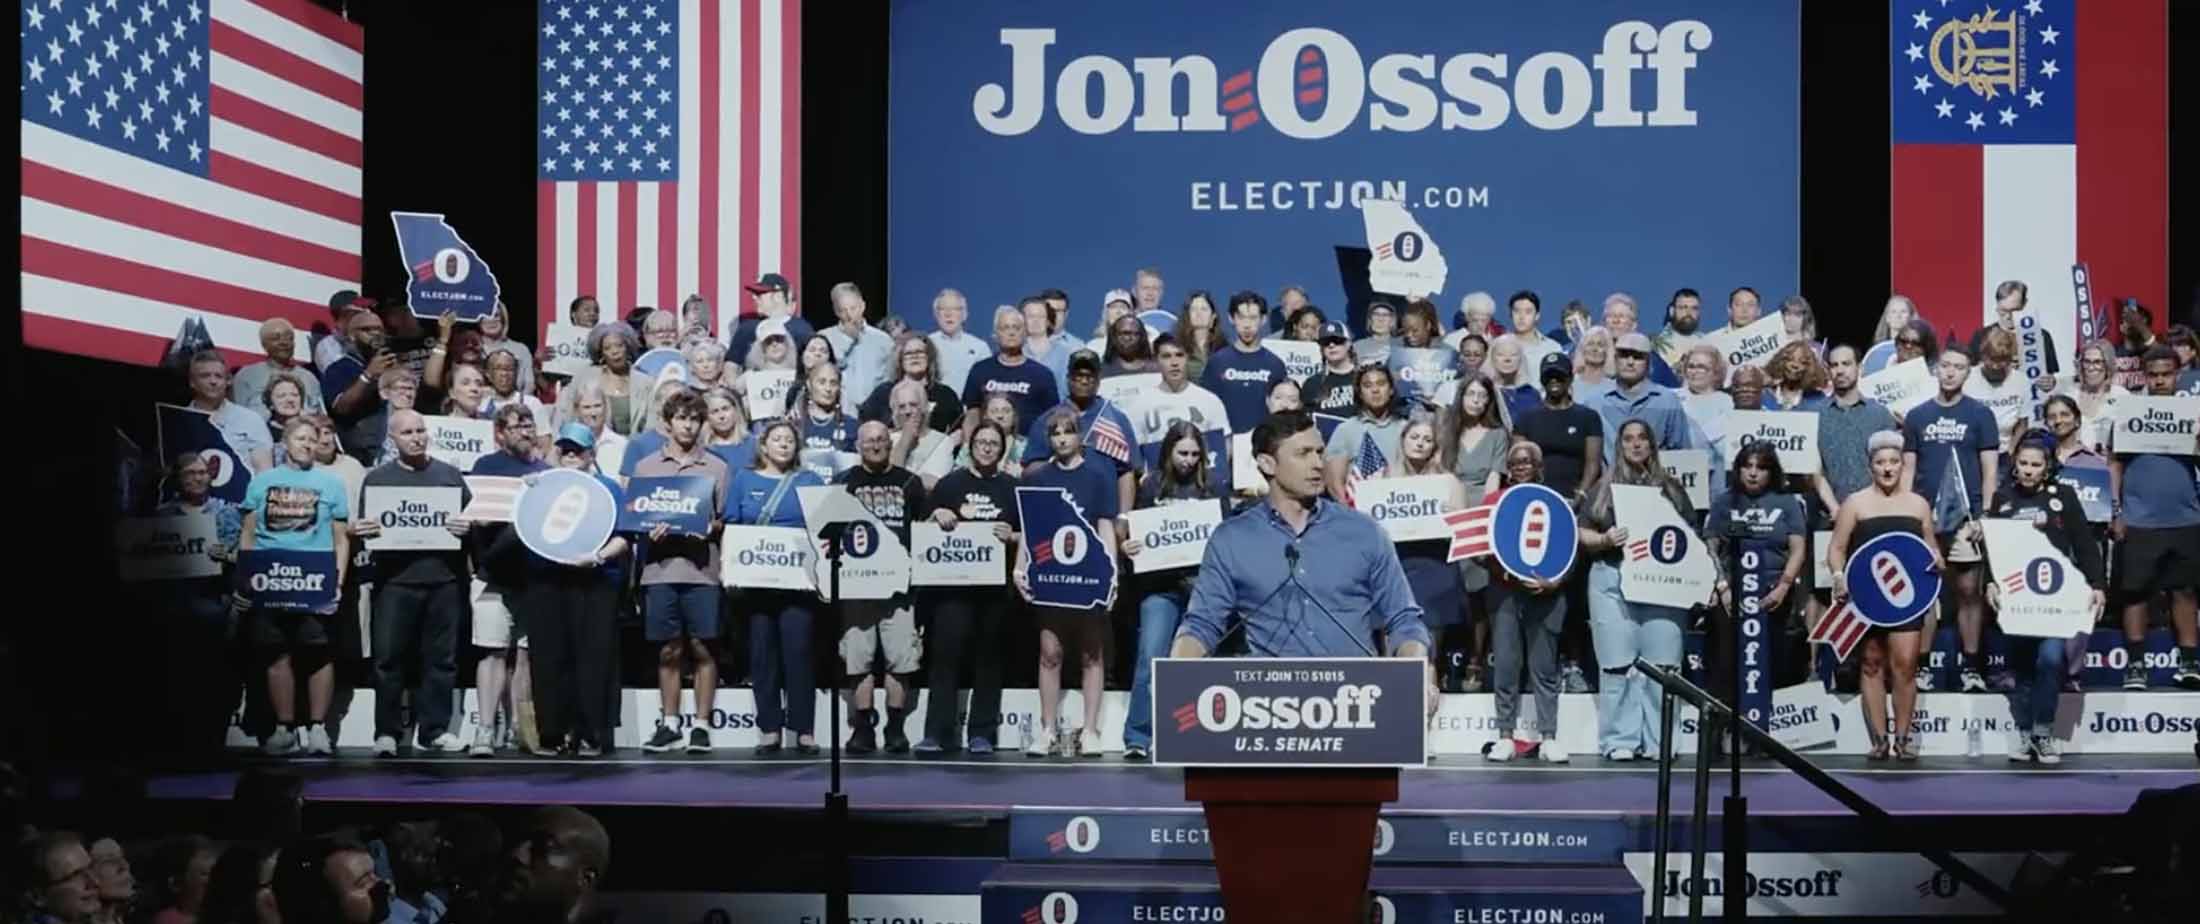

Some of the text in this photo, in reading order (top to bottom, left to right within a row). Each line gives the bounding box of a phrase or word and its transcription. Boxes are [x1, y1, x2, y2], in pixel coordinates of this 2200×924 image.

[973, 19, 1713, 140] Jon Ossoff
[1729, 333, 1778, 366] Ossoff
[1739, 335, 1764, 350] Jon
[1286, 351, 1312, 364] Jon
[1224, 368, 1271, 382] Ossoff
[985, 380, 1031, 394] Ossoff
[2144, 408, 2174, 421] Jon
[435, 426, 463, 440] Jon
[1756, 424, 1786, 437] Jon
[1926, 423, 1968, 434] Ossoff
[2127, 418, 2195, 434] Ossoff
[434, 439, 484, 453] ssoff
[1740, 433, 1807, 451] Ooff
[650, 486, 681, 500] Jon
[1386, 491, 1416, 504] Jon
[397, 500, 428, 513] Jon
[633, 496, 700, 514] Ossoff
[1371, 498, 1439, 520] Ossoff
[381, 511, 450, 528] Ossoff
[1160, 519, 1189, 532] Jon
[942, 535, 972, 549] Jon
[1145, 523, 1211, 549] Ossoff
[755, 539, 785, 553] Jon
[739, 550, 806, 567] Ossoff
[926, 546, 994, 563] Ossoff
[268, 562, 302, 576] Jon
[251, 573, 326, 592] Ossoff
[2108, 647, 2181, 669] Osof
[1234, 670, 1345, 682] TEXT JOIN TO 51015
[1197, 684, 1382, 732] Ossoff
[1911, 709, 1929, 719] on
[710, 708, 757, 729] Oss
[1770, 705, 1818, 731] ssoff
[1887, 717, 1950, 733] Osoff
[2090, 711, 2138, 733] Jon
[1234, 737, 1344, 751] U.S. SENATE
[1150, 829, 1209, 844] ELECT
[1448, 831, 1588, 847] ELECTJON.COM
[1454, 907, 1605, 924] ELECTJON.COM
